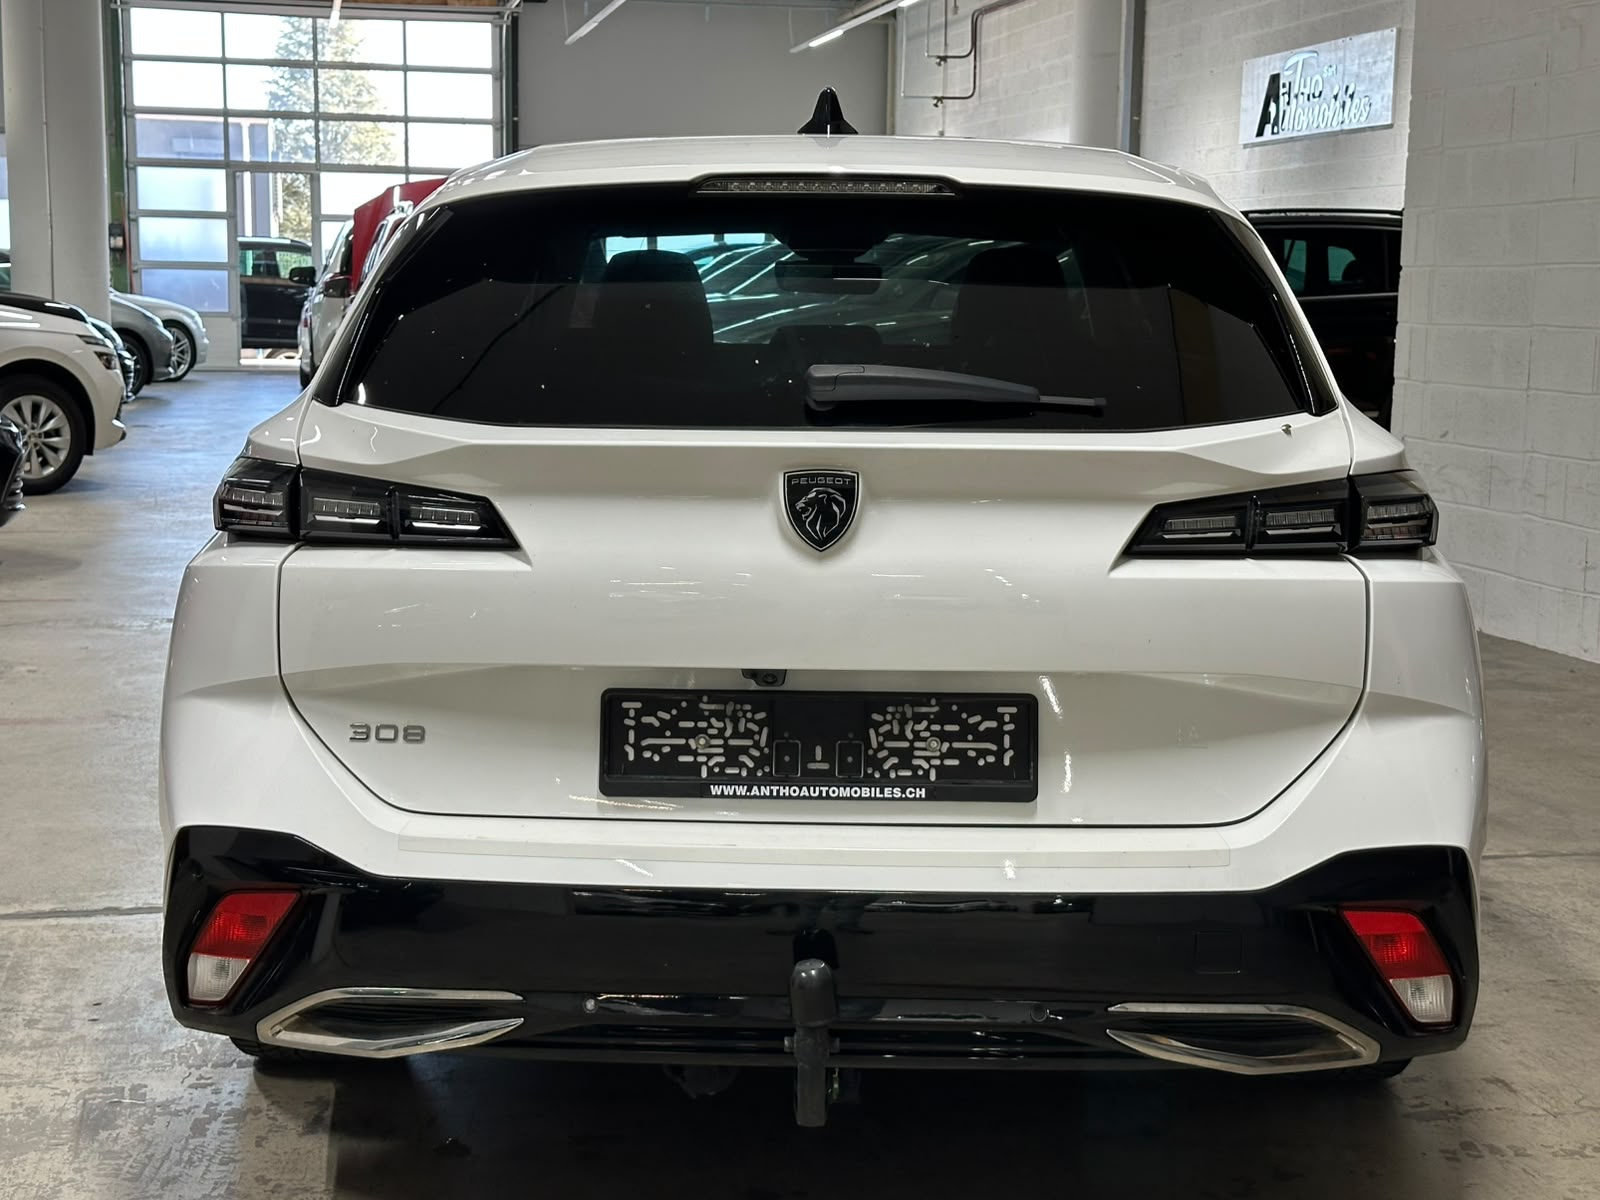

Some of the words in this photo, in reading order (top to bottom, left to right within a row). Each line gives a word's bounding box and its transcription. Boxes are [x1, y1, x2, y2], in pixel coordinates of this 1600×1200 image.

[791, 476, 852, 485] PEUGEOT
[349, 723, 426, 744] 308
[709, 784, 926, 798] WWW.ANTHOAUTOMOBILES.CH
